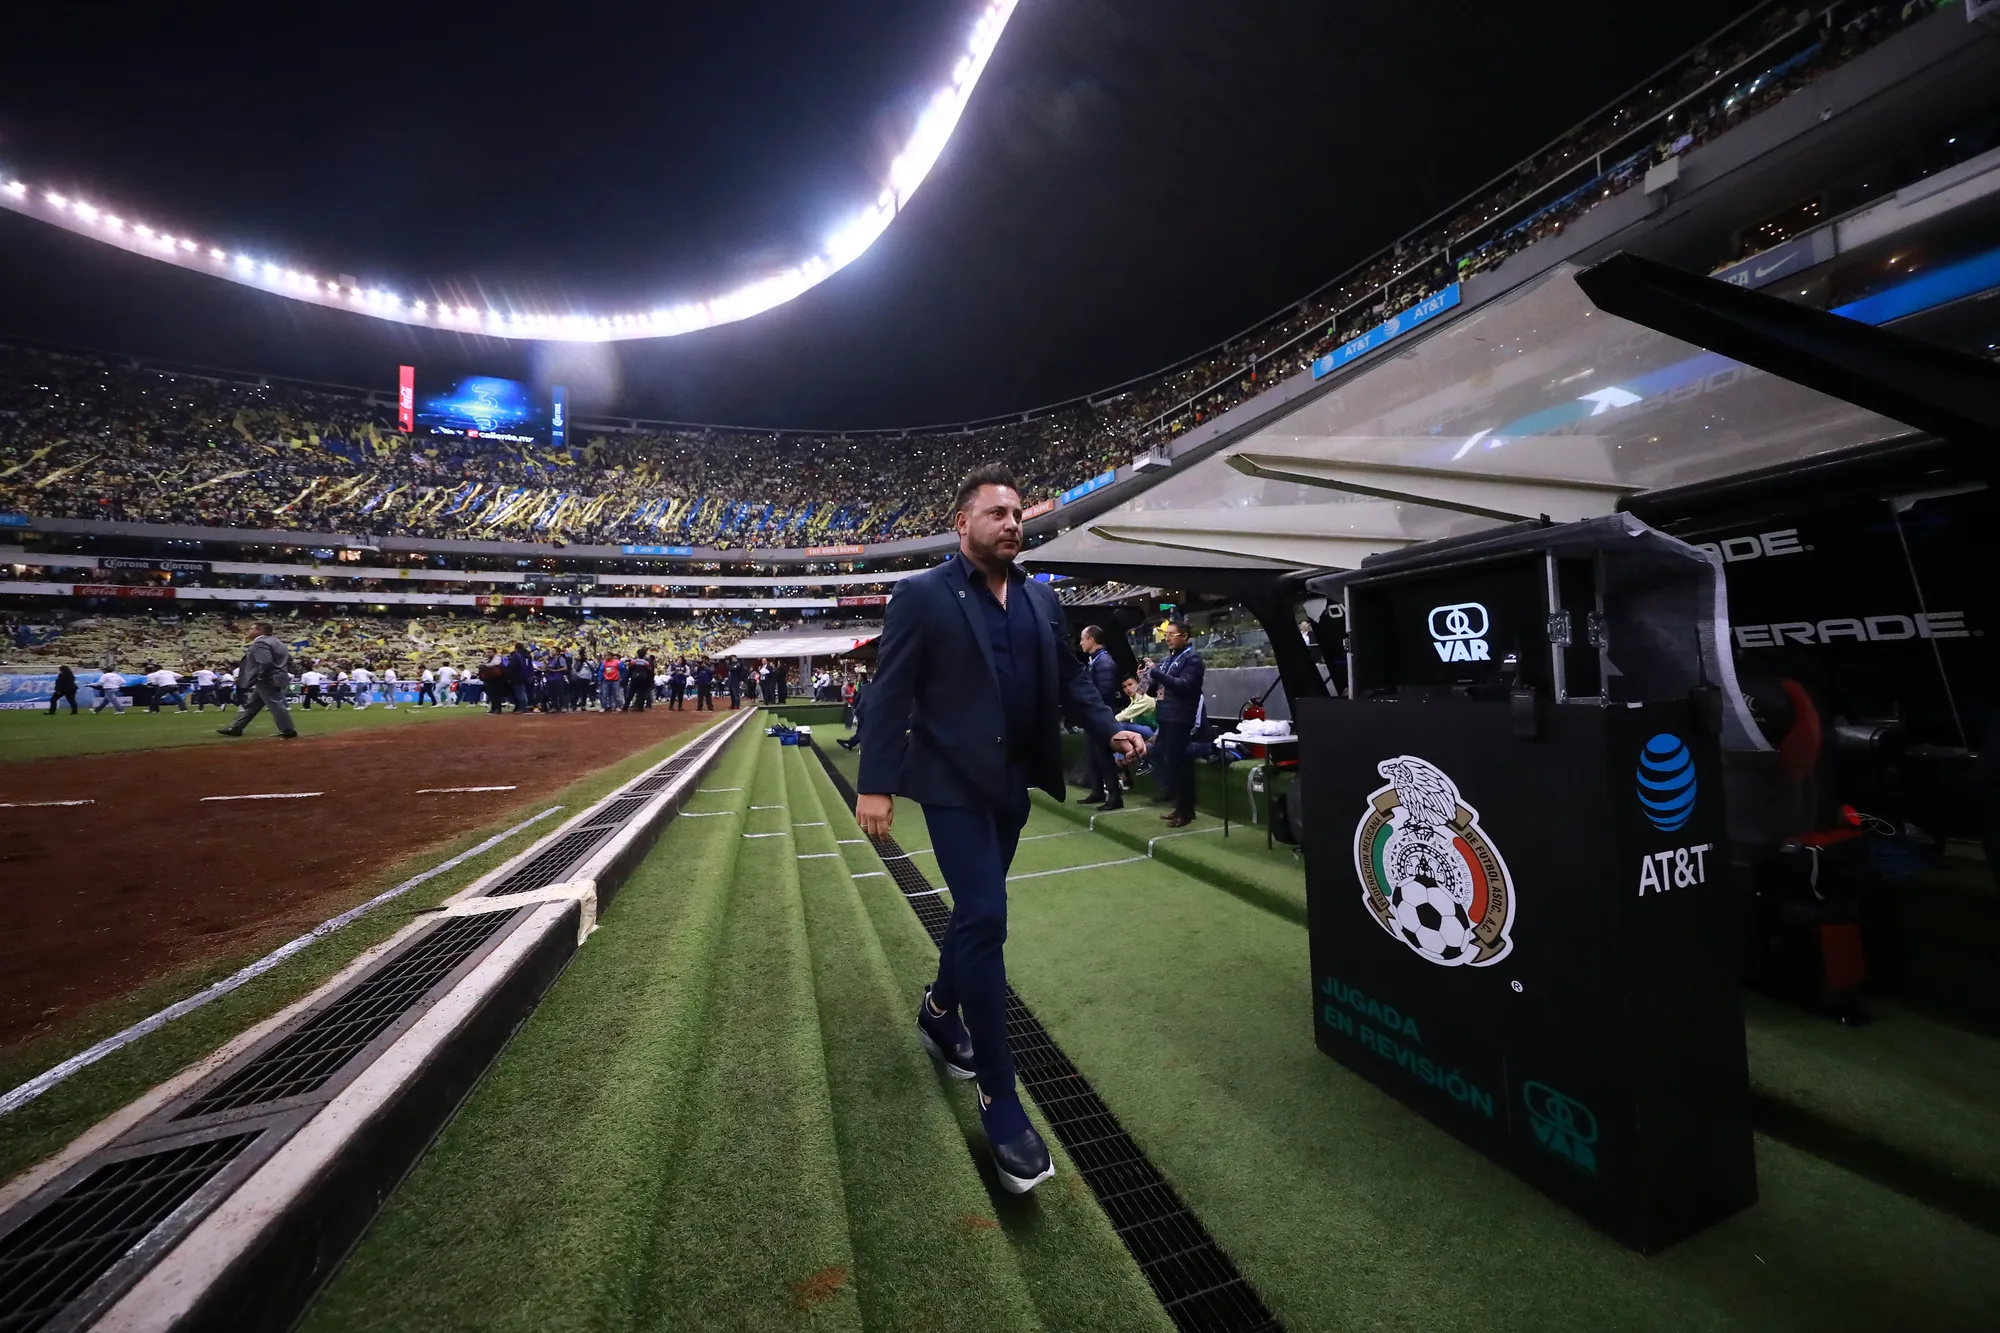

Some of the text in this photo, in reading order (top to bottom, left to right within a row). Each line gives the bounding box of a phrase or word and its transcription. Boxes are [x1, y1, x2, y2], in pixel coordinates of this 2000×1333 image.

[1414, 294, 1446, 320] AT&T
[1345, 335, 1371, 357] AT&T
[104, 558, 150, 569] Corona
[160, 561, 203, 571] Corona
[1433, 639, 1491, 662] VAR
[14, 680, 55, 694] AT&
[1363, 817, 1387, 907] FEDERACION MEXICANA
[1465, 832, 1479, 845] DE
[1475, 846, 1499, 883] FUTBOL
[1639, 844, 1709, 896] AT&T
[1321, 975, 1422, 1043] JUGADA
[1324, 1003, 1494, 1119] EN REVISIÓN
[1529, 1113, 1599, 1176] VAR
